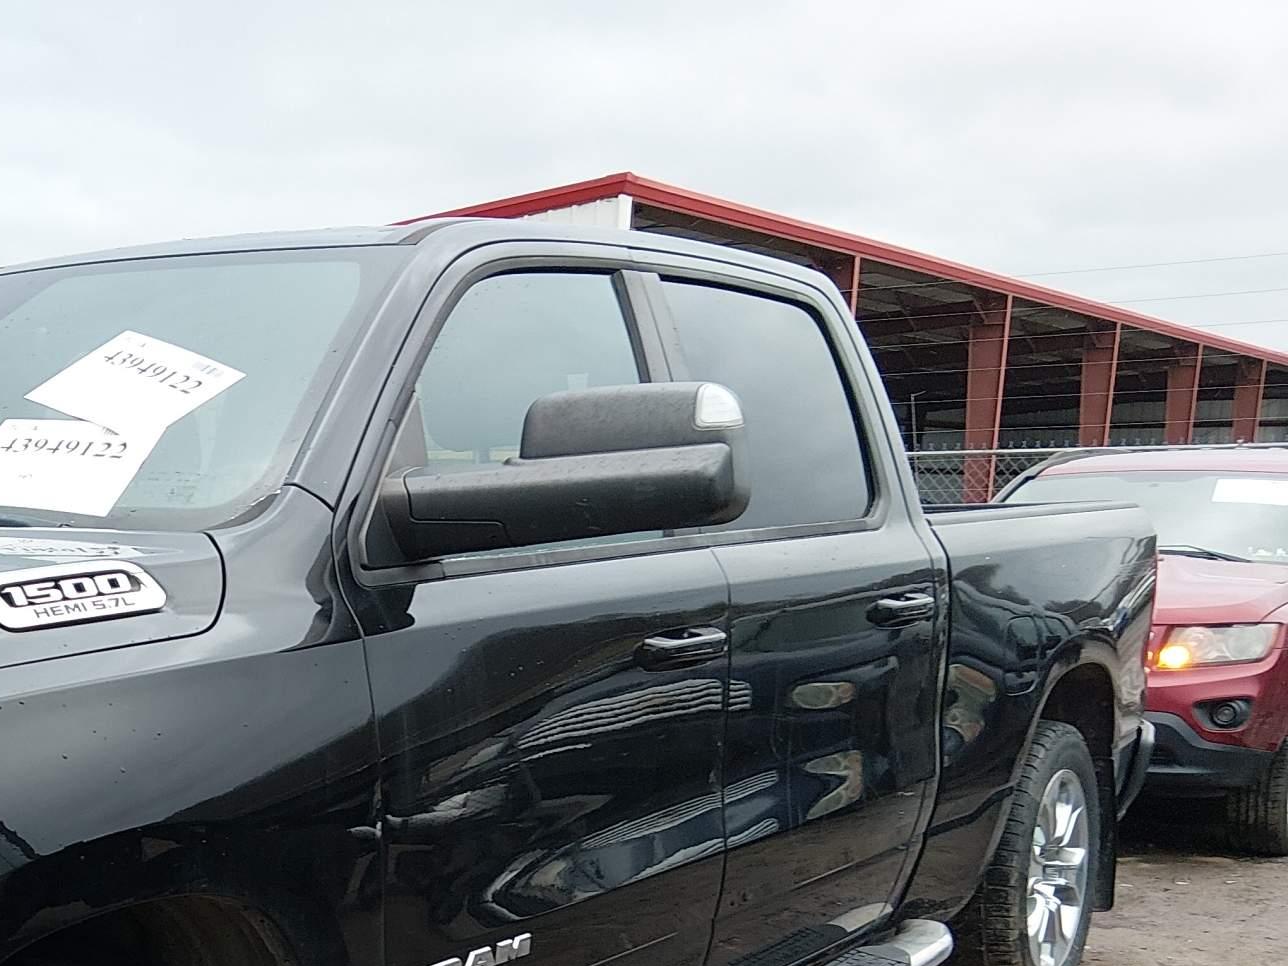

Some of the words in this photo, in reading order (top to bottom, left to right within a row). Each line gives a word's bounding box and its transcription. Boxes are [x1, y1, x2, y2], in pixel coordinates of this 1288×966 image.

[103, 351, 203, 394] 43949122
[0, 438, 128, 459] 43949122
[1, 571, 133, 607] 1500
[33, 602, 88, 618] HEMI
[92, 596, 135, 610] 5.7L
